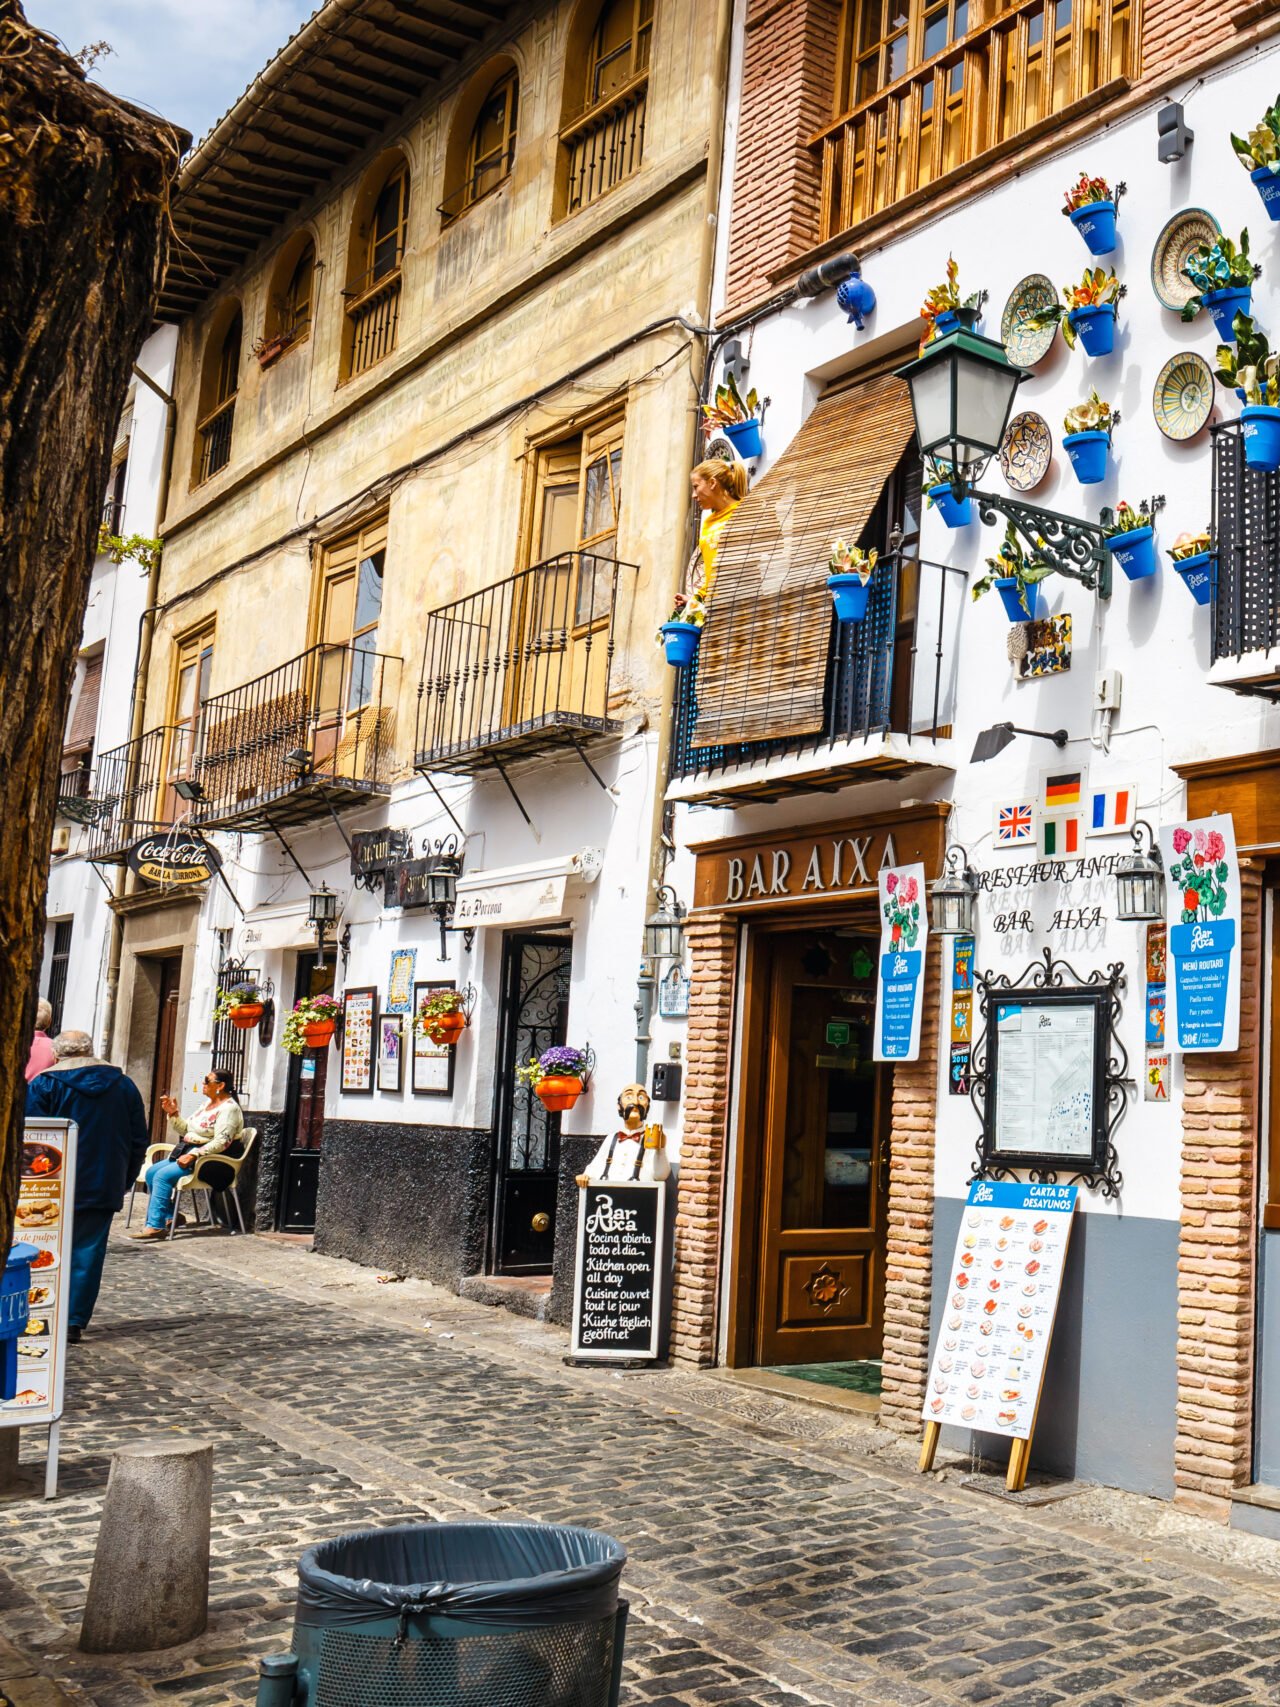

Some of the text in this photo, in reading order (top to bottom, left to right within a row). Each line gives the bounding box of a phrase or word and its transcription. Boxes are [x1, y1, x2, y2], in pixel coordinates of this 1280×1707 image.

[725, 833, 897, 901] BAR AIXA
[993, 906, 1107, 934] BAR AIXA
[1192, 925, 1212, 939] Bar
[1191, 934, 1214, 952] Aixa
[1148, 1058, 1168, 1066] 2015
[24, 1131, 58, 1141] RCILLA
[1029, 1186, 1056, 1198] CARTA
[1057, 1188, 1070, 1198] DE
[595, 1194, 638, 1220] Bar
[1022, 1197, 1072, 1210] DESAYUNOS
[585, 1205, 638, 1233] Aixa
[20, 1232, 57, 1243] de pulpo
[588, 1232, 652, 1244] Cocina abierta
[589, 1244, 610, 1255] todo
[611, 1243, 620, 1255] el
[586, 1257, 651, 1274] Kitchen open
[586, 1272, 623, 1287] all day
[585, 1286, 650, 1299] Cuisine ouvret
[585, 1300, 640, 1315] tout le jour
[582, 1312, 651, 1330] Küche täglich
[582, 1328, 629, 1344] geöffnet
